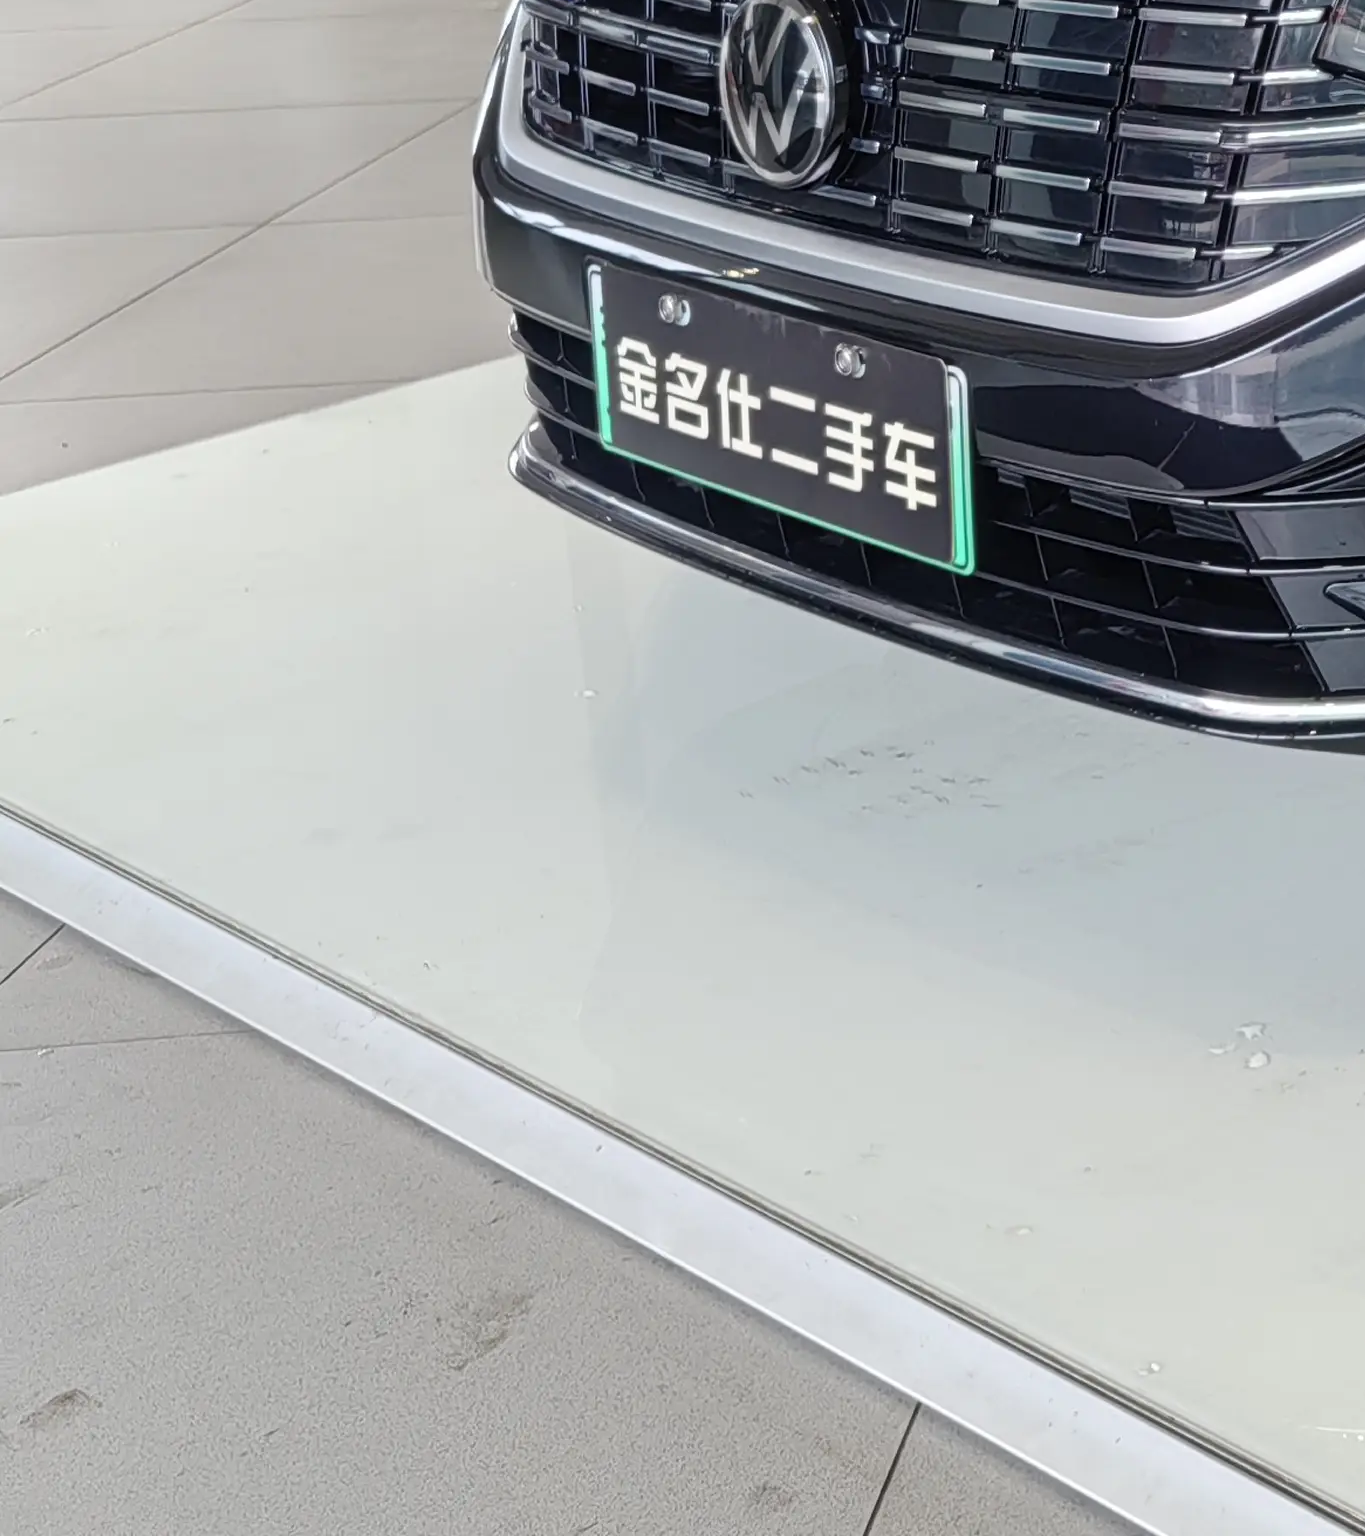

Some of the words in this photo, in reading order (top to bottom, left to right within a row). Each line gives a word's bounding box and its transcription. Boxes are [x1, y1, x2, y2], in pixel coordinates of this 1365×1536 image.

[616, 335, 937, 511] 金名仕二手车
